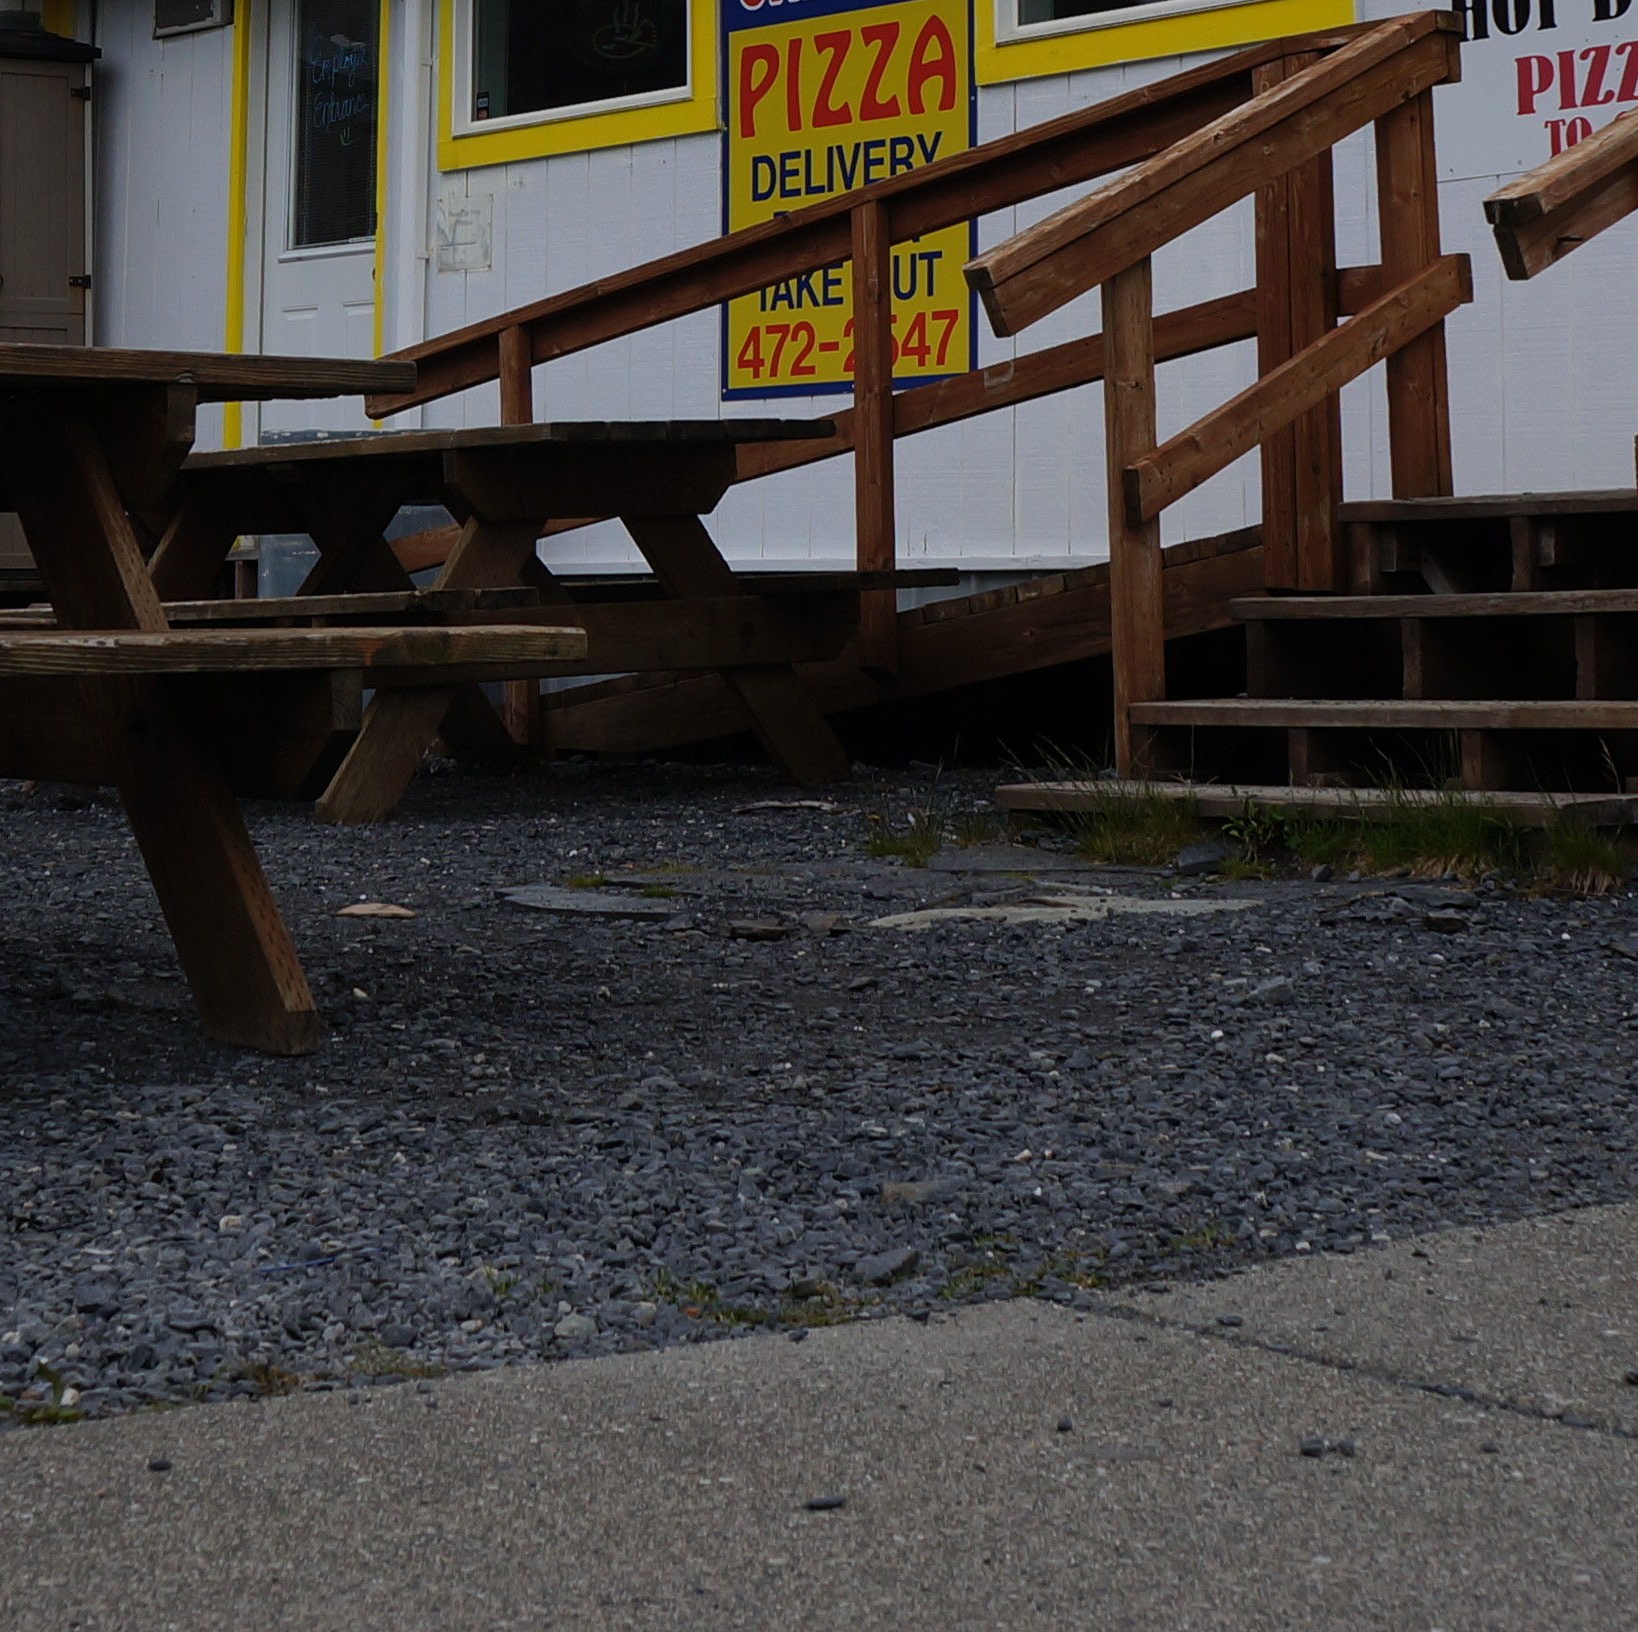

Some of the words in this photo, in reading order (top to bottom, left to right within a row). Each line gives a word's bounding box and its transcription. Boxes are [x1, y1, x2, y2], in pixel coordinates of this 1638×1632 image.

[740, 14, 956, 139] PIZZA
[751, 131, 943, 202] DELIVERY
[1544, 117, 1593, 159] TO
[893, 250, 943, 301] UT
[737, 309, 959, 380] 472-247
